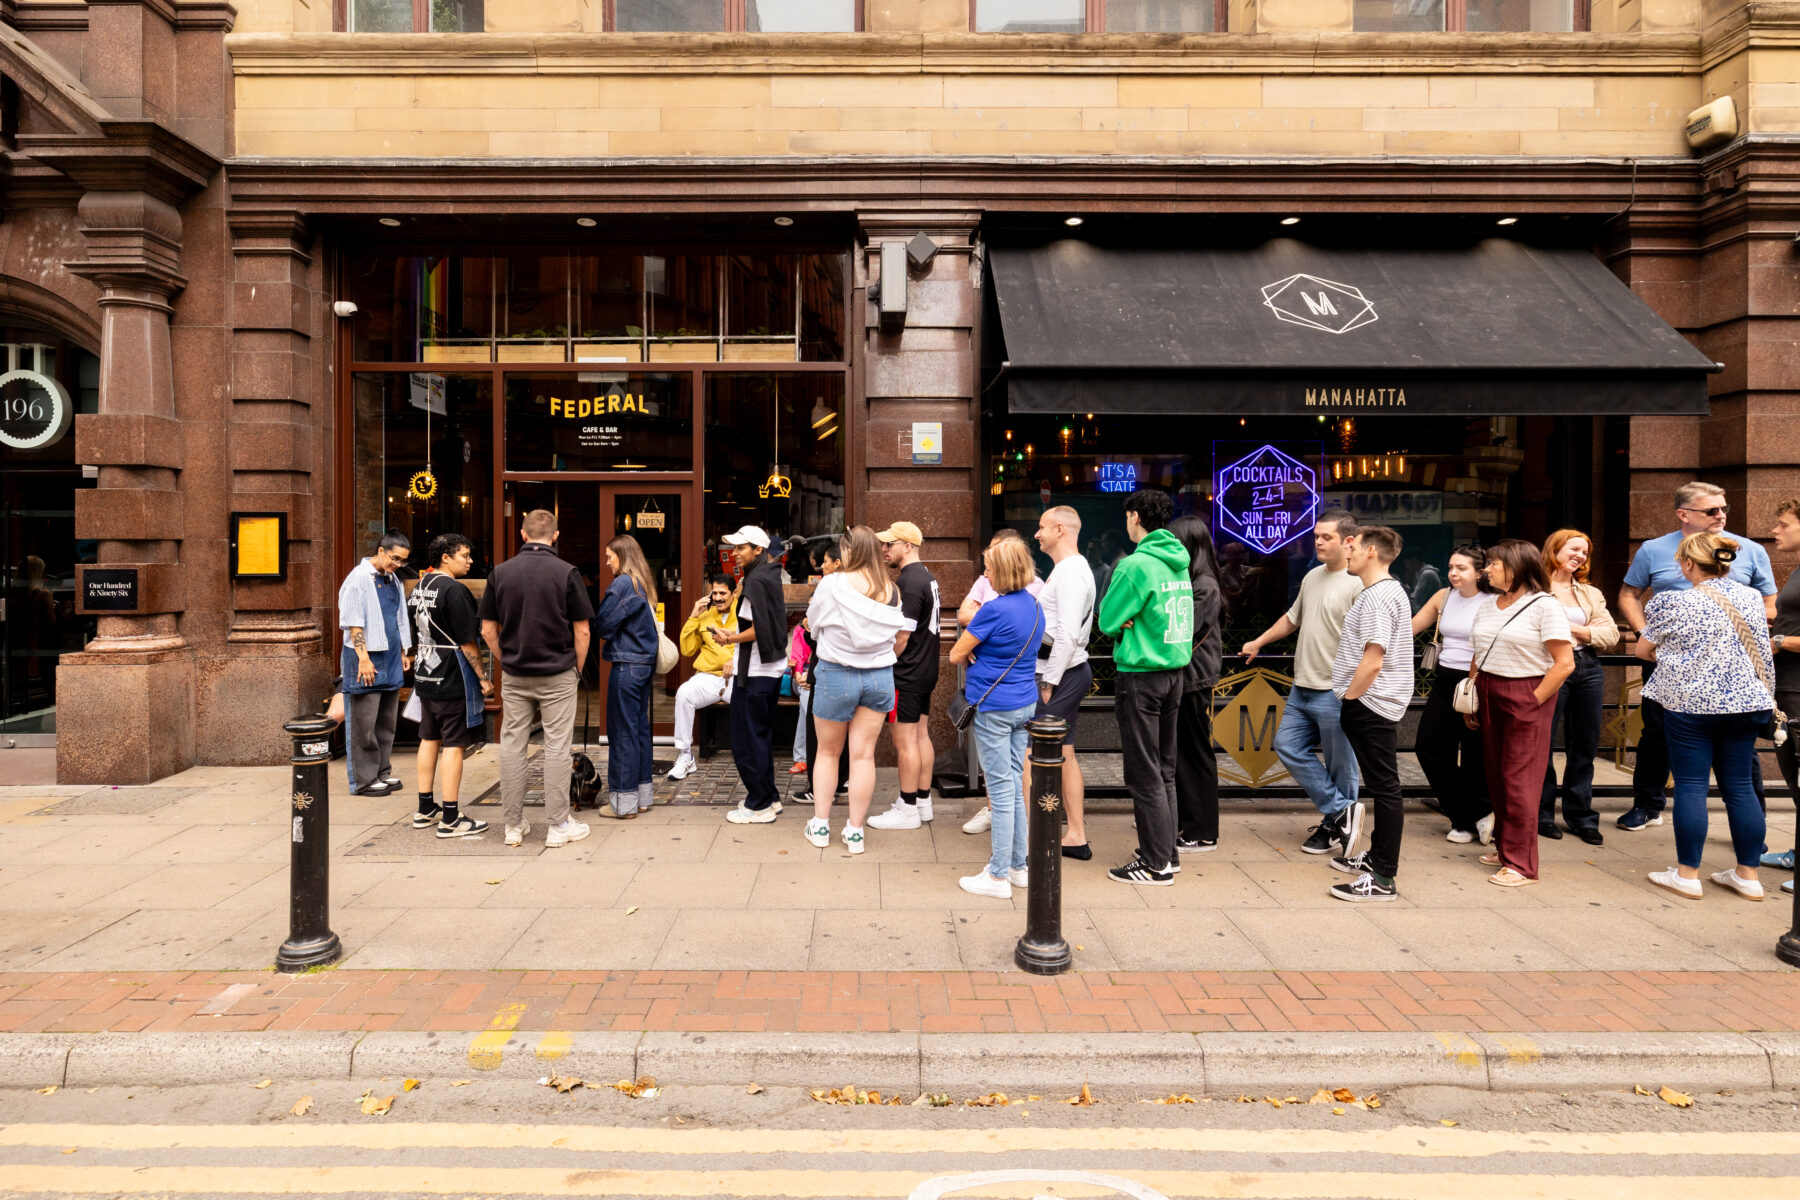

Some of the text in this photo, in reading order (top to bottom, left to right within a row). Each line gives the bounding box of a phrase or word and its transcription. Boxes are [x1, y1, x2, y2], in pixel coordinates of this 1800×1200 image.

[1300, 291, 1338, 315] M
[550, 393, 649, 418] FEDERAL
[1305, 388, 1407, 406] MANAHATTA
[3, 397, 44, 421] 196
[1126, 464, 1136, 478] A
[1233, 466, 1303, 482] COCKTAILS
[1252, 486, 1284, 506] 2-4-1
[639, 518, 663, 526] OPEN
[1245, 525, 1288, 539] ALL DAY
[96, 590, 117, 598] Ninety
[1239, 704, 1277, 752] M
